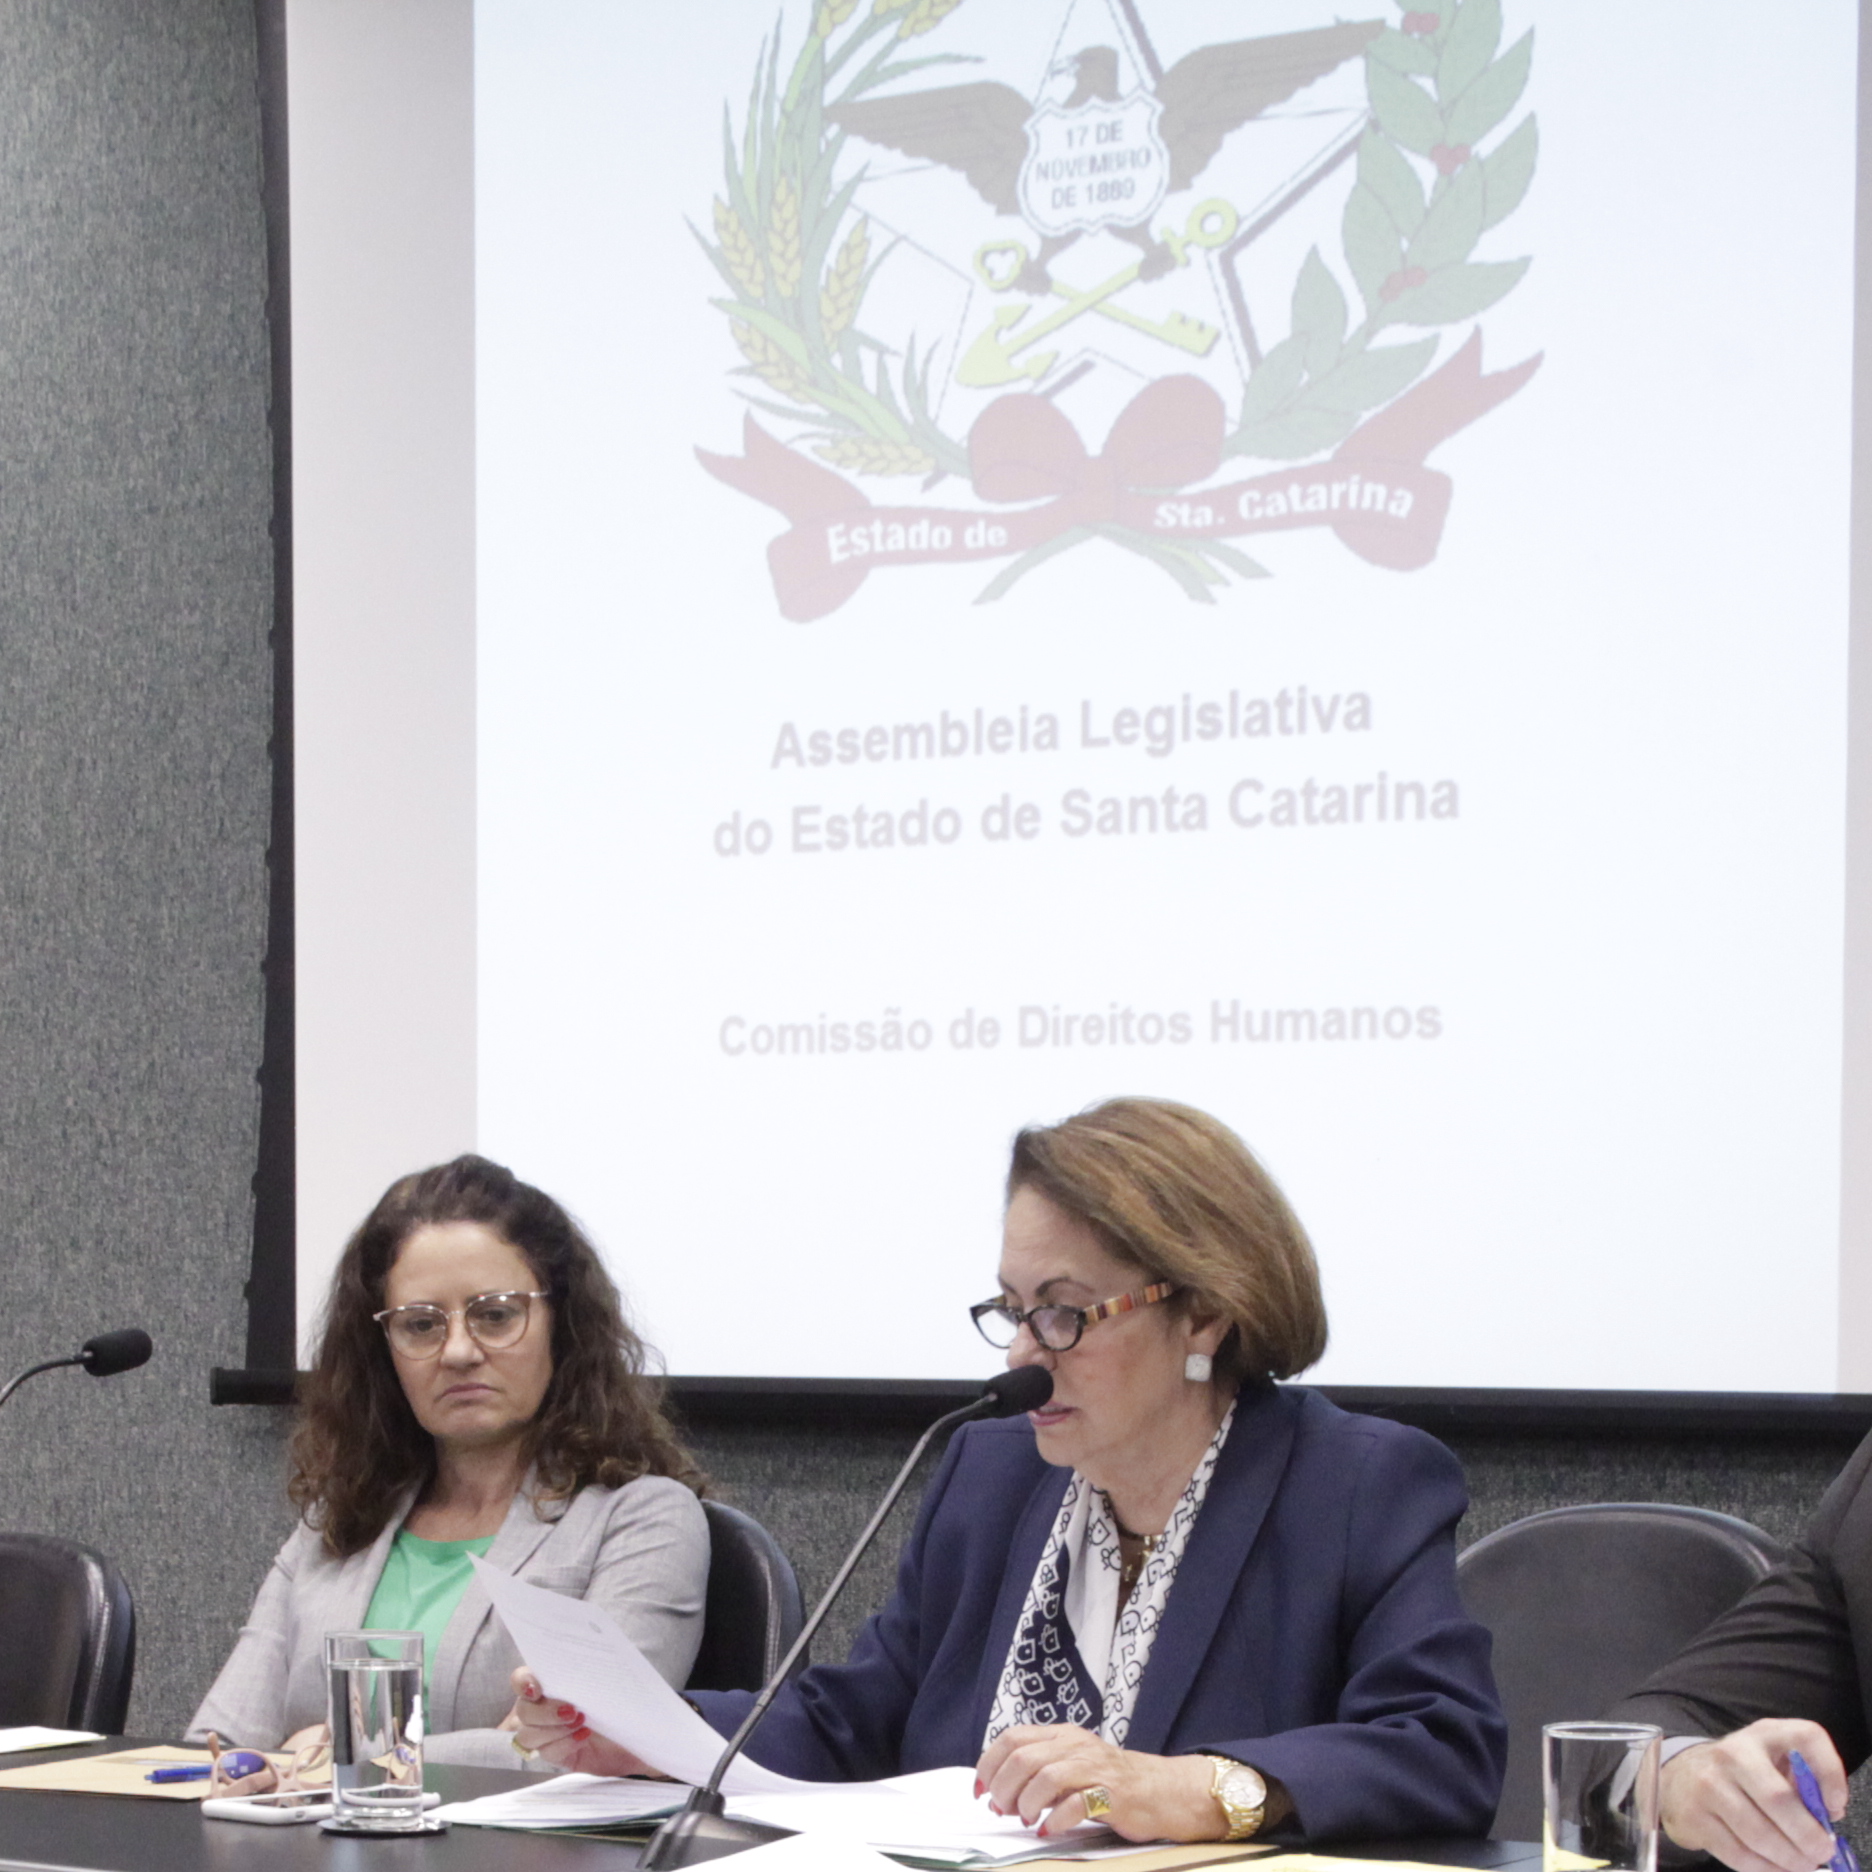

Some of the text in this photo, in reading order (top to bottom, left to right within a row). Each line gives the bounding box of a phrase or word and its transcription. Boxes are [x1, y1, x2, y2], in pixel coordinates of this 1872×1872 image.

[1066, 119, 1124, 149] 17 DE
[1035, 146, 1152, 182] NOVEMBRO
[1051, 185, 1077, 211] DE
[1153, 473, 1415, 528] Sta. Catarina
[826, 517, 1008, 565] Estado de
[769, 684, 1373, 769] Assembleia Legislativa
[712, 770, 1461, 859] do Estado de Santa Catarina
[718, 998, 1444, 1056] Comissão de Direitos Humanos
